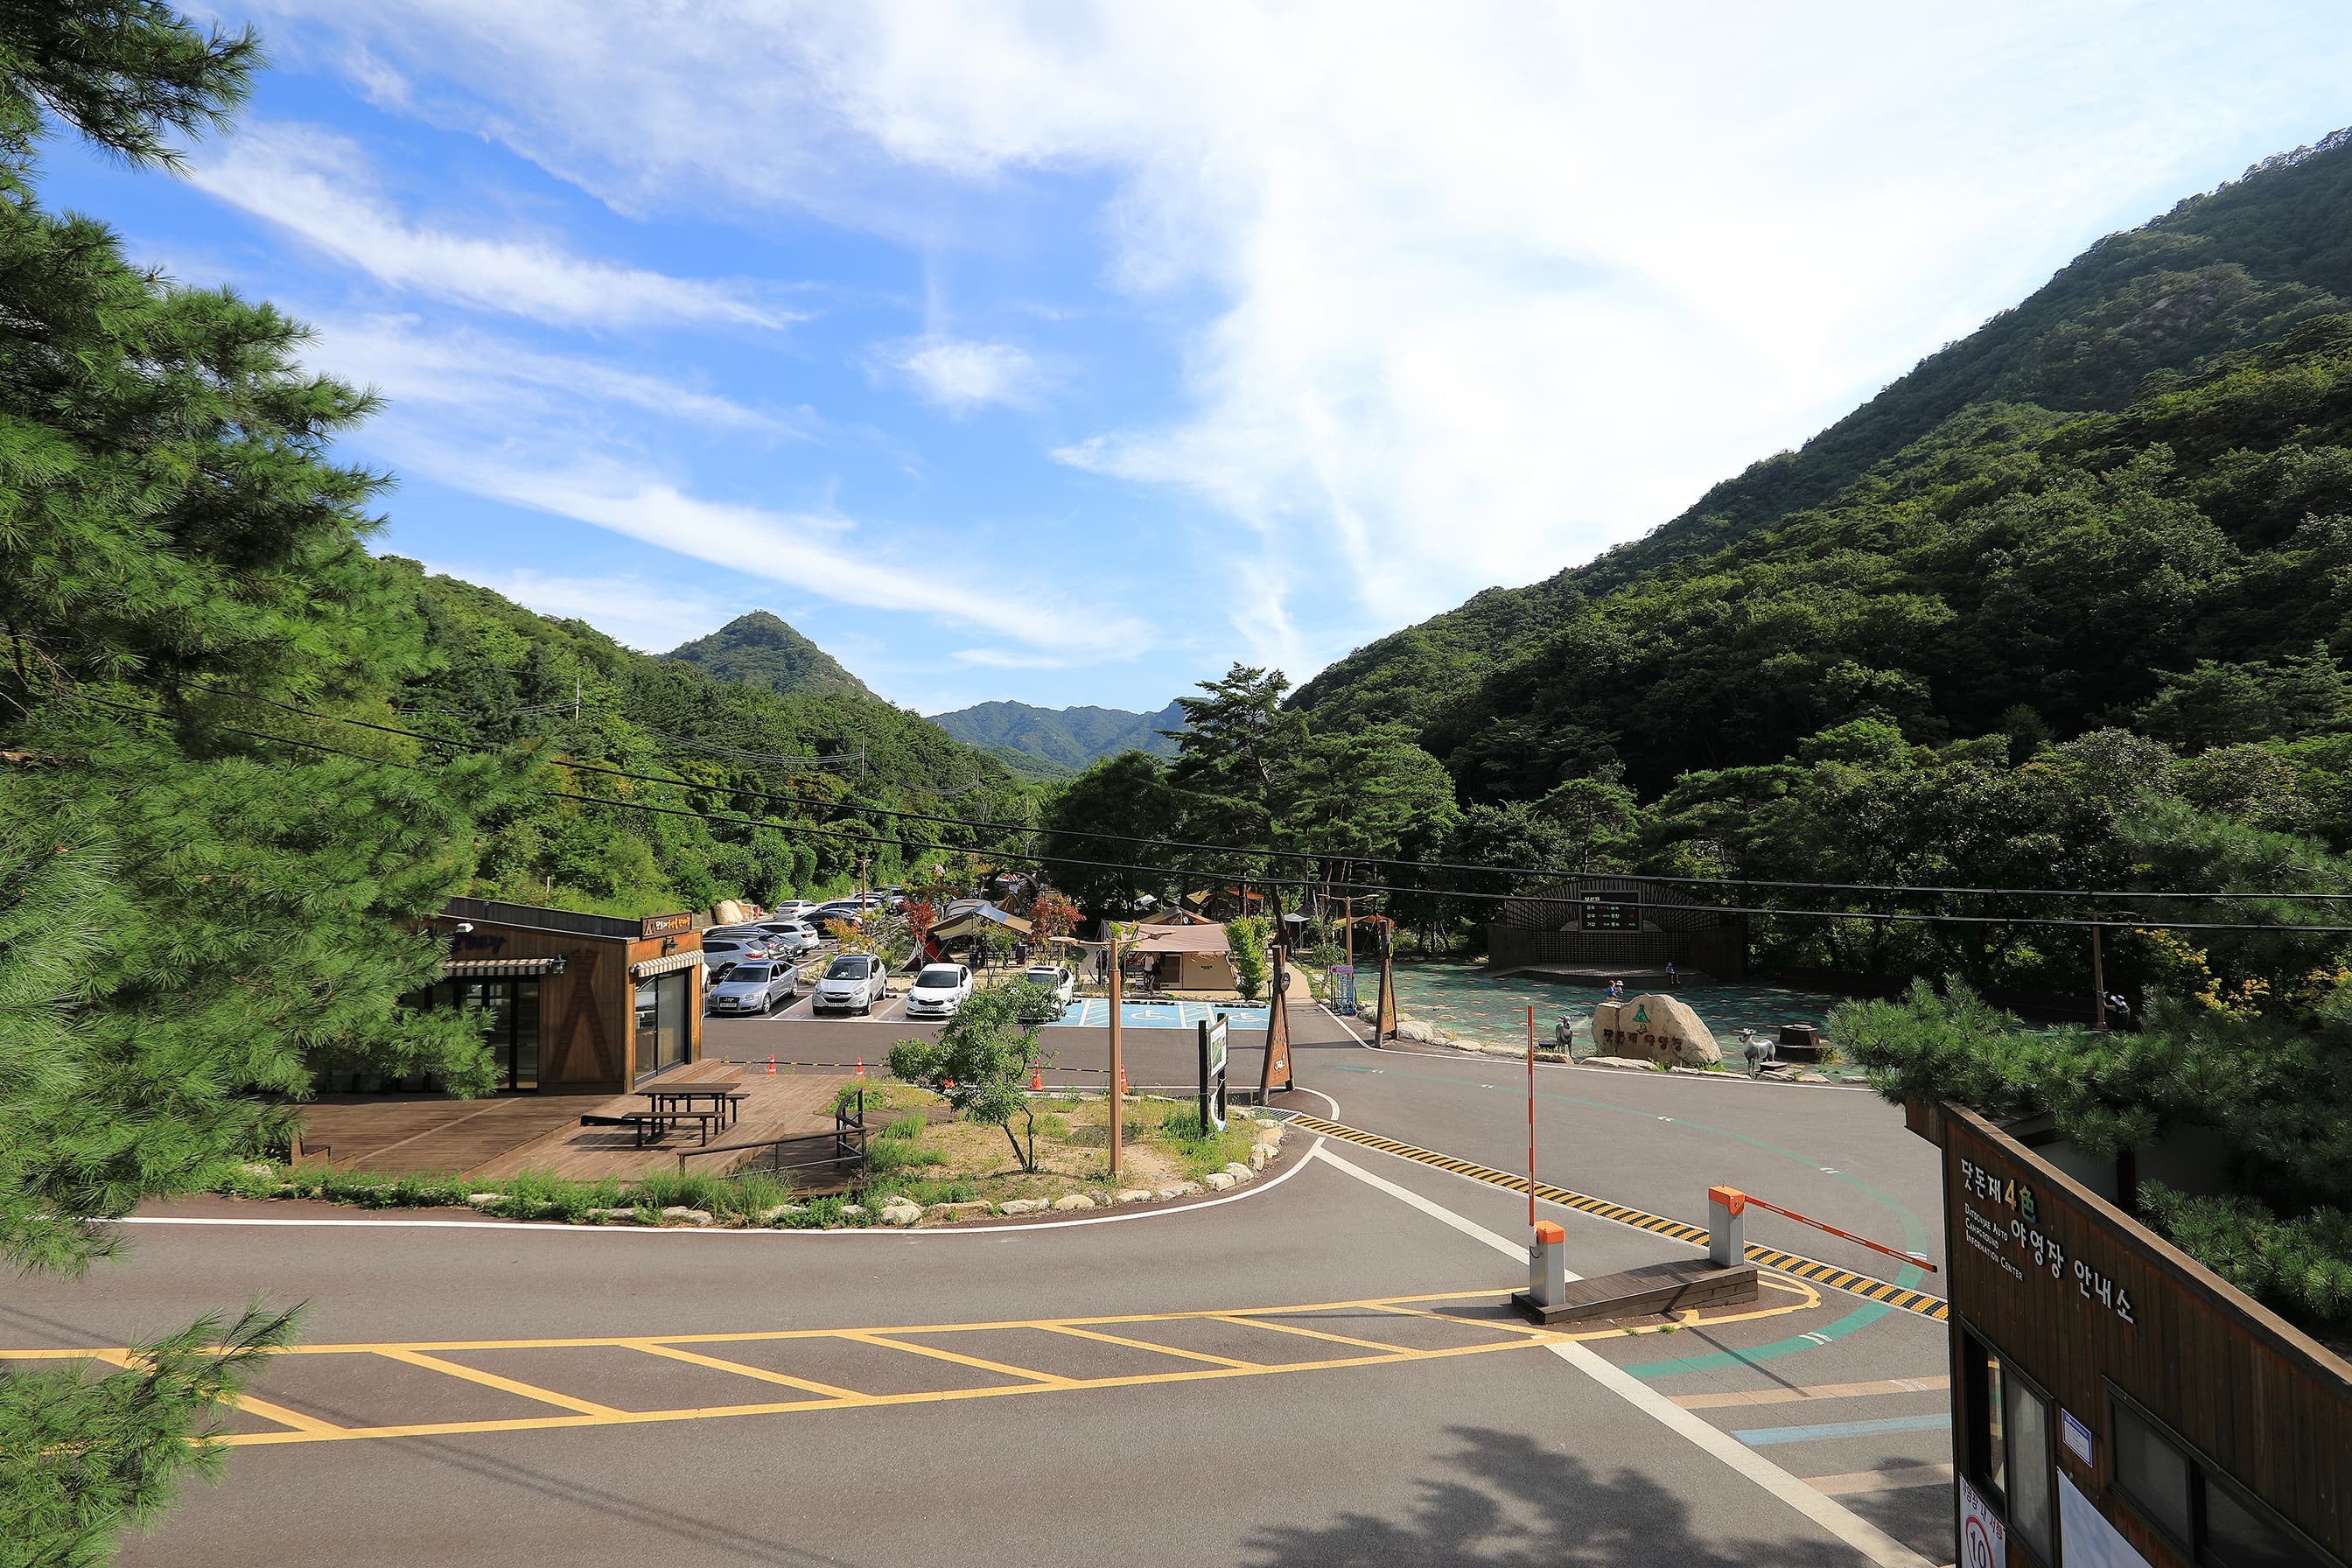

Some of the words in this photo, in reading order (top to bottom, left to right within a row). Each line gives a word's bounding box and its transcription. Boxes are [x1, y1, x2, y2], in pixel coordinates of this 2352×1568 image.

[2011, 1219, 2065, 1279] 야영장
[2074, 1259, 2135, 1325] 안내소
[1970, 1530, 1986, 1568] 10
